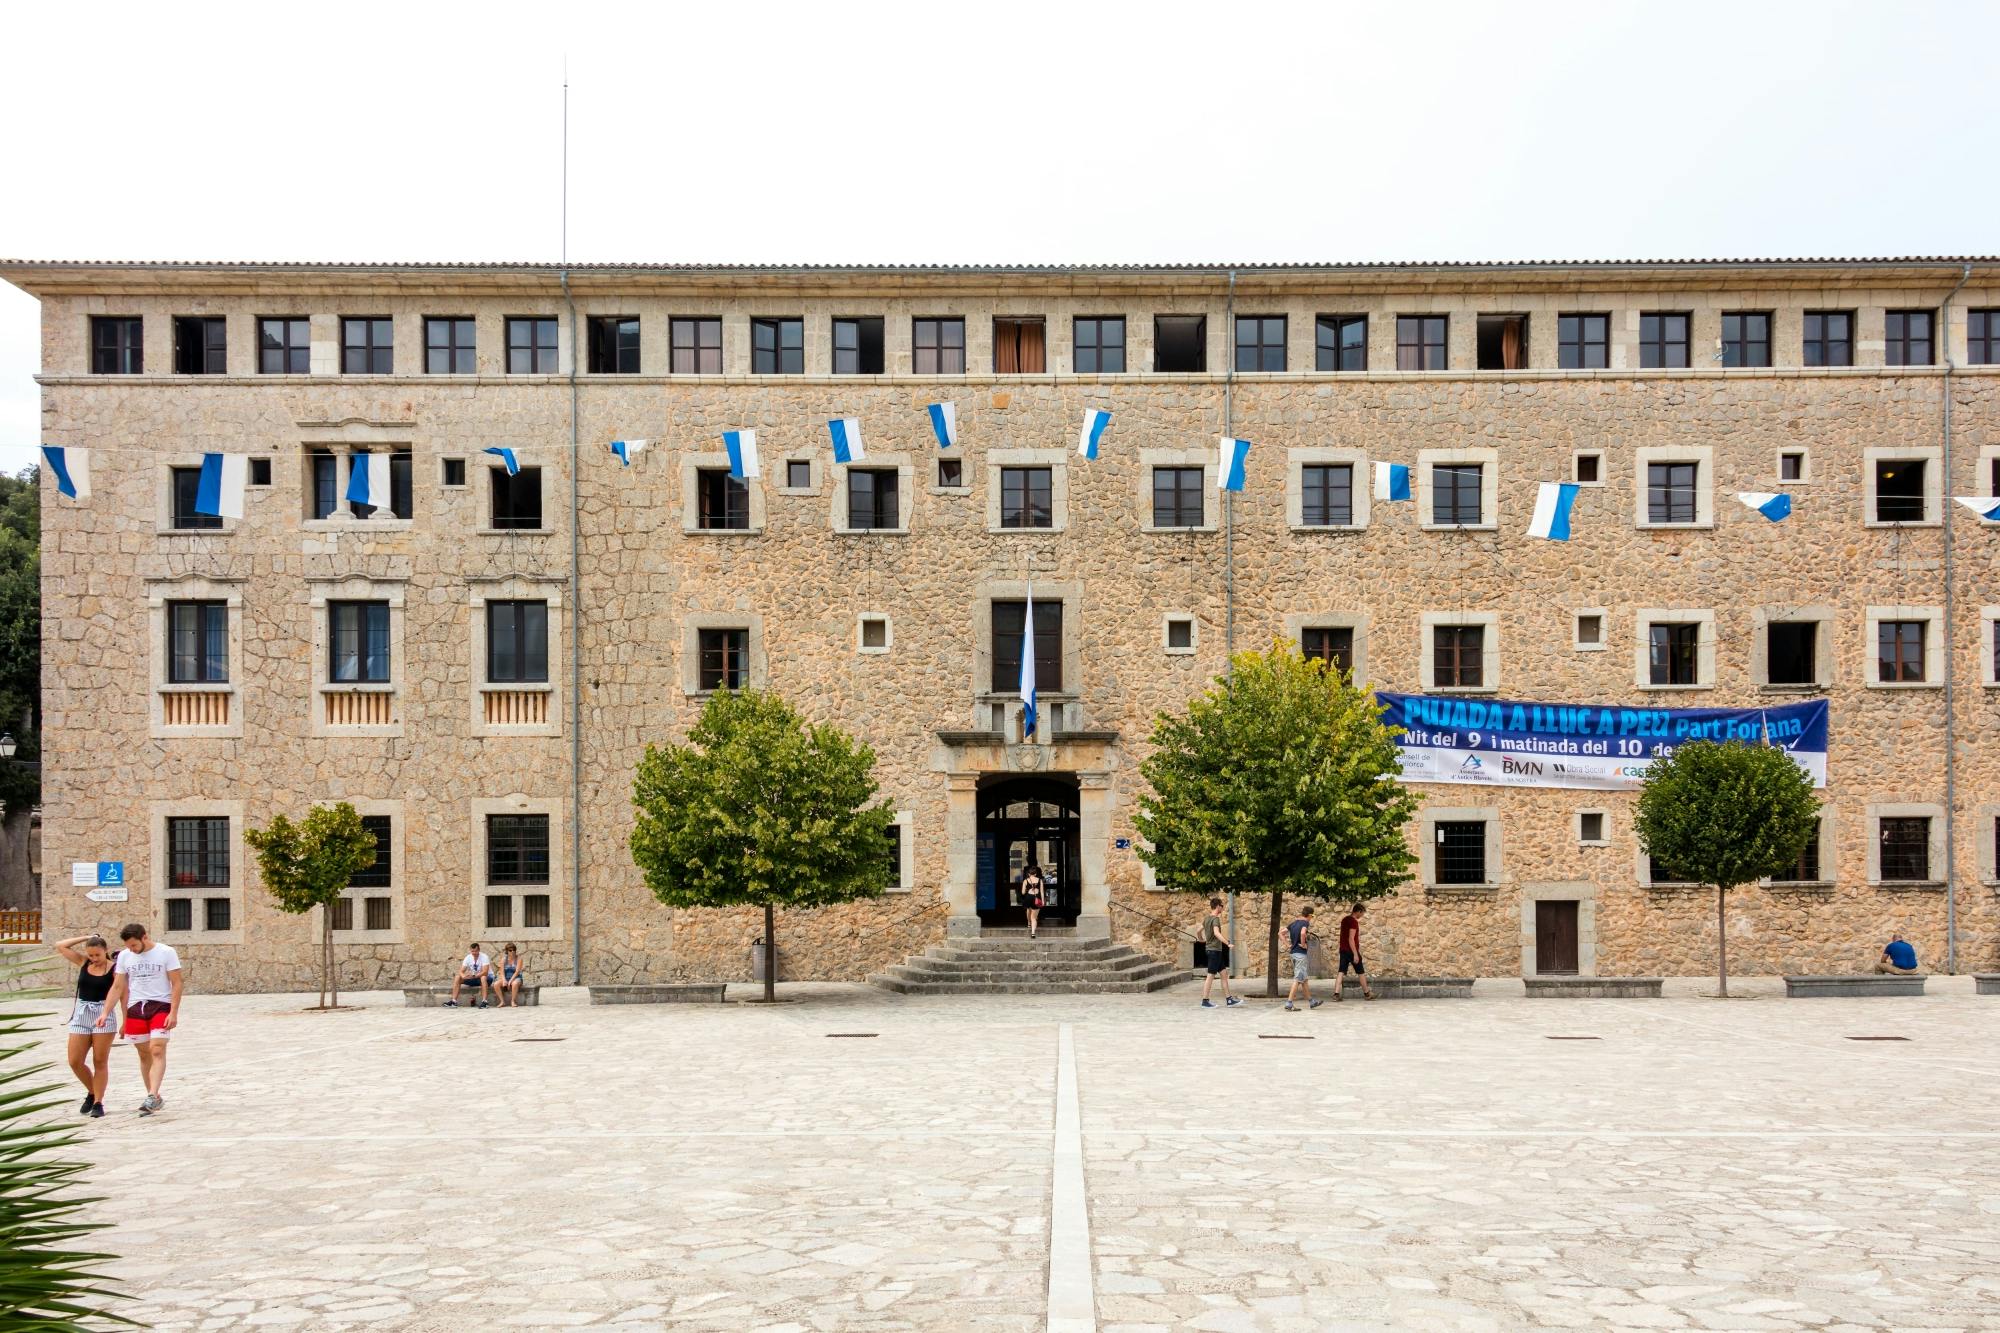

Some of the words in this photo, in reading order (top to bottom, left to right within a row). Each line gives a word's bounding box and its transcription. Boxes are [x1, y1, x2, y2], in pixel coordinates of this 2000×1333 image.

[1404, 698, 1503, 731] PUJADA
[1506, 705, 1527, 732] A
[1532, 706, 1591, 735] LLUC
[1596, 709, 1614, 736] A
[1620, 710, 1670, 737] PEU
[1676, 718, 1721, 738] Part
[1726, 718, 1803, 740] Forana
[1404, 730, 1428, 745] Nit
[1432, 732, 1457, 747] del
[1468, 732, 1482, 748] 9
[1491, 735, 1497, 749] i
[1501, 736, 1578, 754] matinada
[1582, 740, 1608, 755] del
[1618, 739, 1643, 756] 10
[1653, 742, 1673, 757] de
[1502, 760, 1544, 776] BMN
[127, 963, 162, 972] ESPRIT
